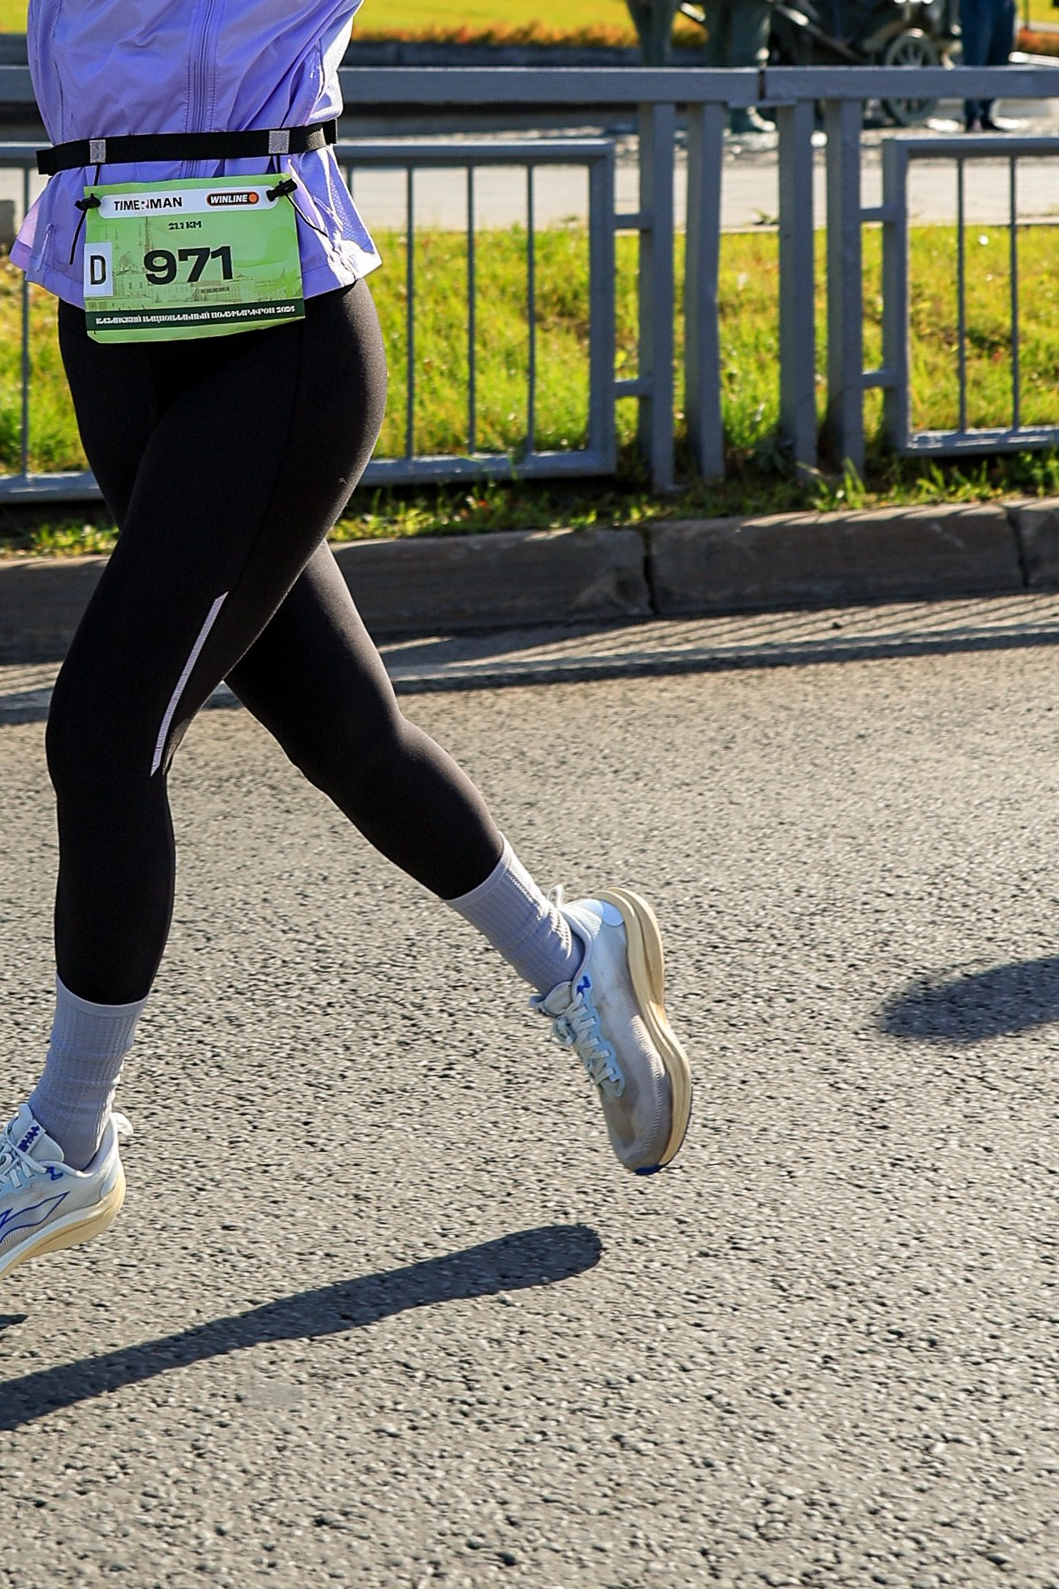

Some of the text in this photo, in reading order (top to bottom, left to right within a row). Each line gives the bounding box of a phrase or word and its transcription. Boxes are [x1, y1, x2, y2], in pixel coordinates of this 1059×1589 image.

[210, 193, 249, 205] WINLINE
[90, 254, 107, 285] D
[143, 245, 234, 285] 971
